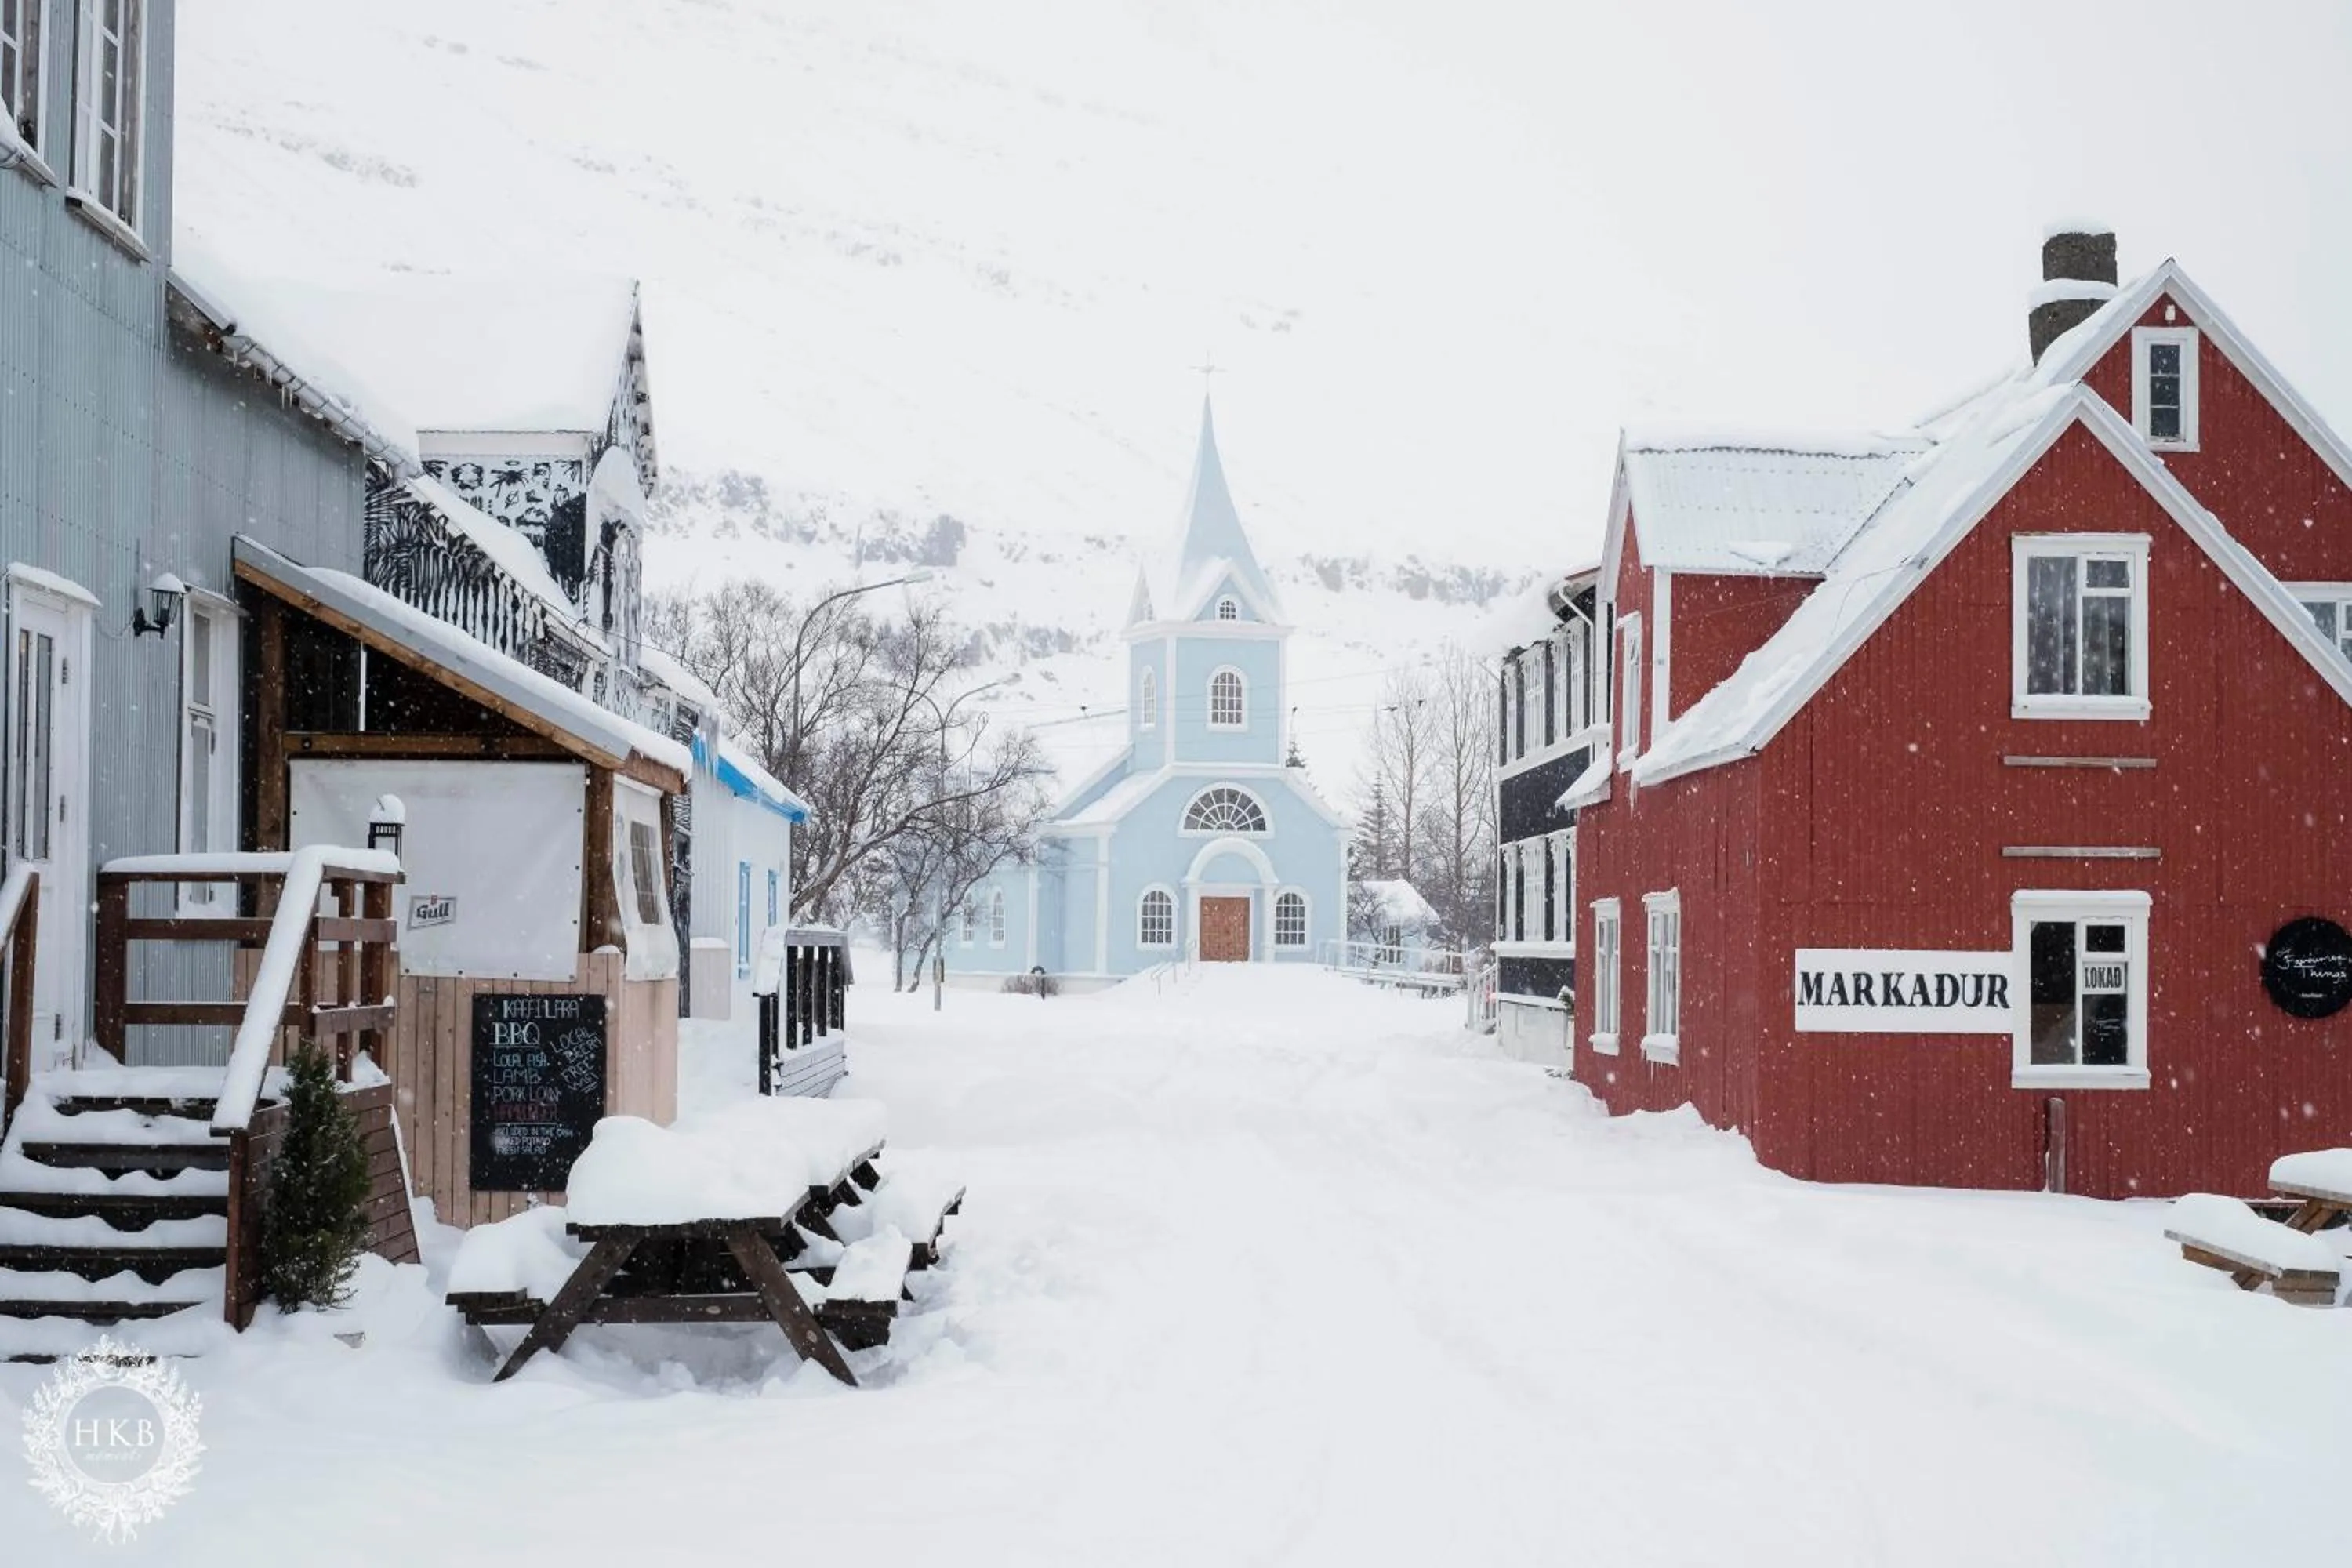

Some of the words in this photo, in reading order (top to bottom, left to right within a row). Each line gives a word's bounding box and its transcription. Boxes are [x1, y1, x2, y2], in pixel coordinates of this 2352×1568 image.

[416, 902, 450, 920] Gull
[491, 1021, 541, 1046] BBQ
[493, 1068, 541, 1084] LAMB
[490, 1086, 526, 1105] PORK
